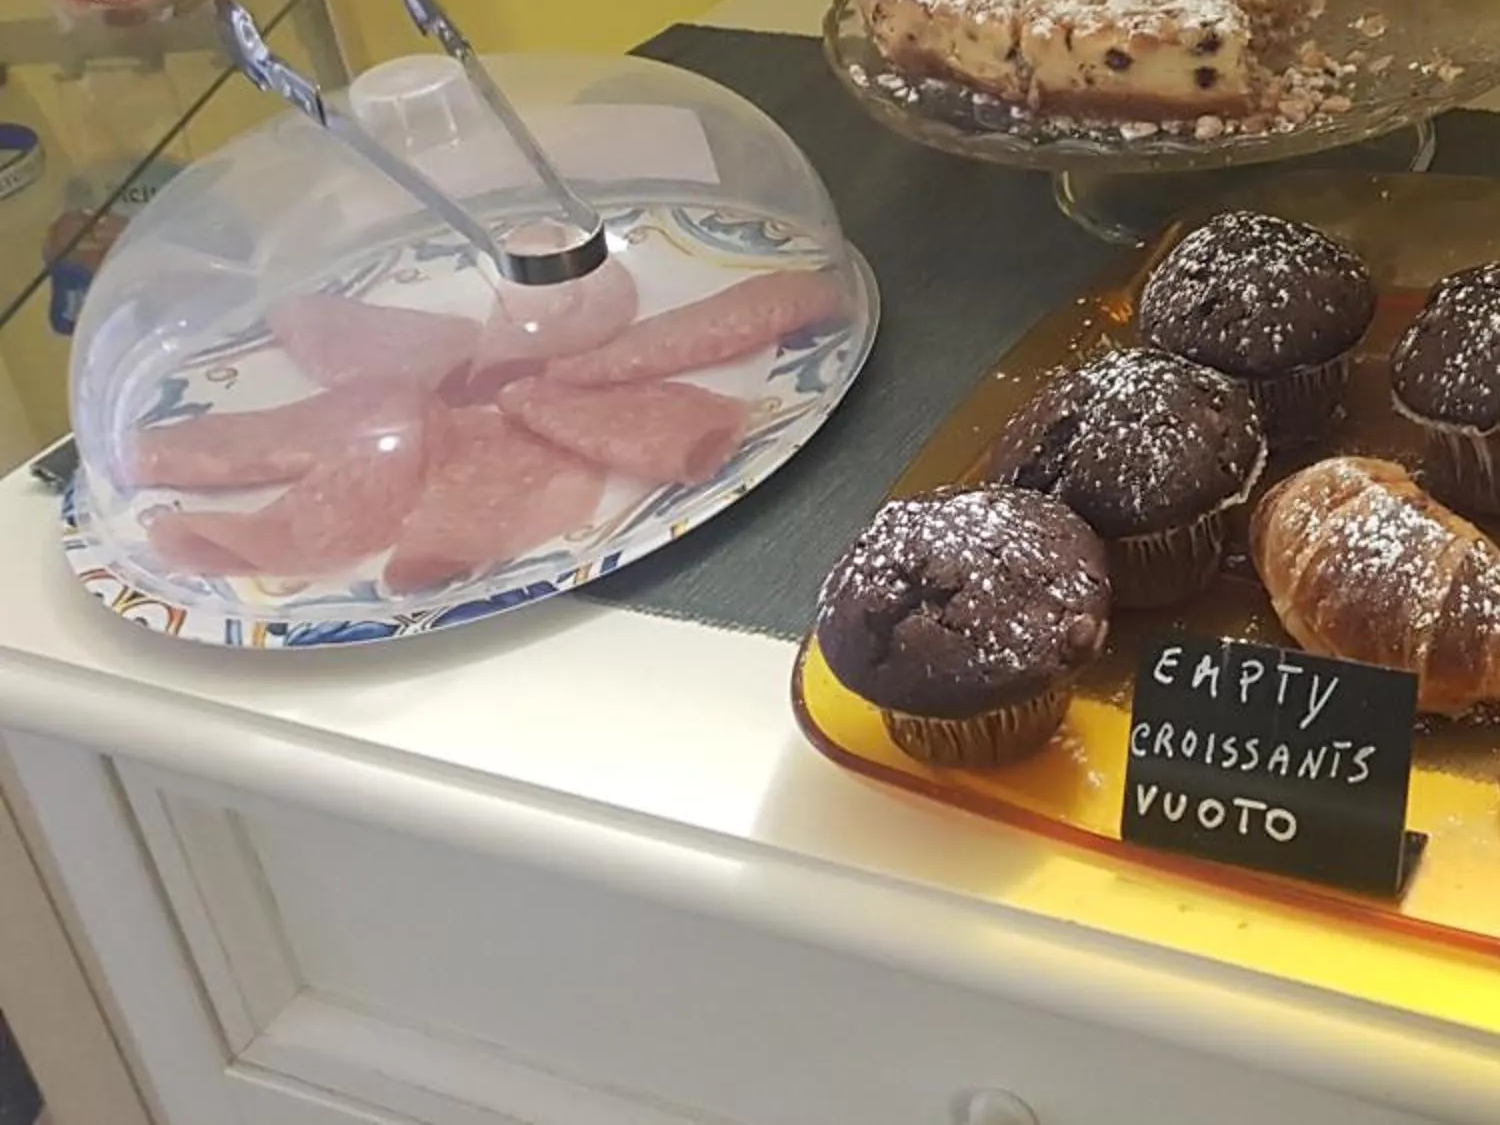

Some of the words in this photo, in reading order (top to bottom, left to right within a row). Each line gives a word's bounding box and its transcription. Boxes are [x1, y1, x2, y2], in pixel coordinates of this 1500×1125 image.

[1152, 647, 1340, 729] EMPTY
[1130, 721, 1378, 784] CROISSANTS
[1135, 784, 1298, 843] VUOTO
